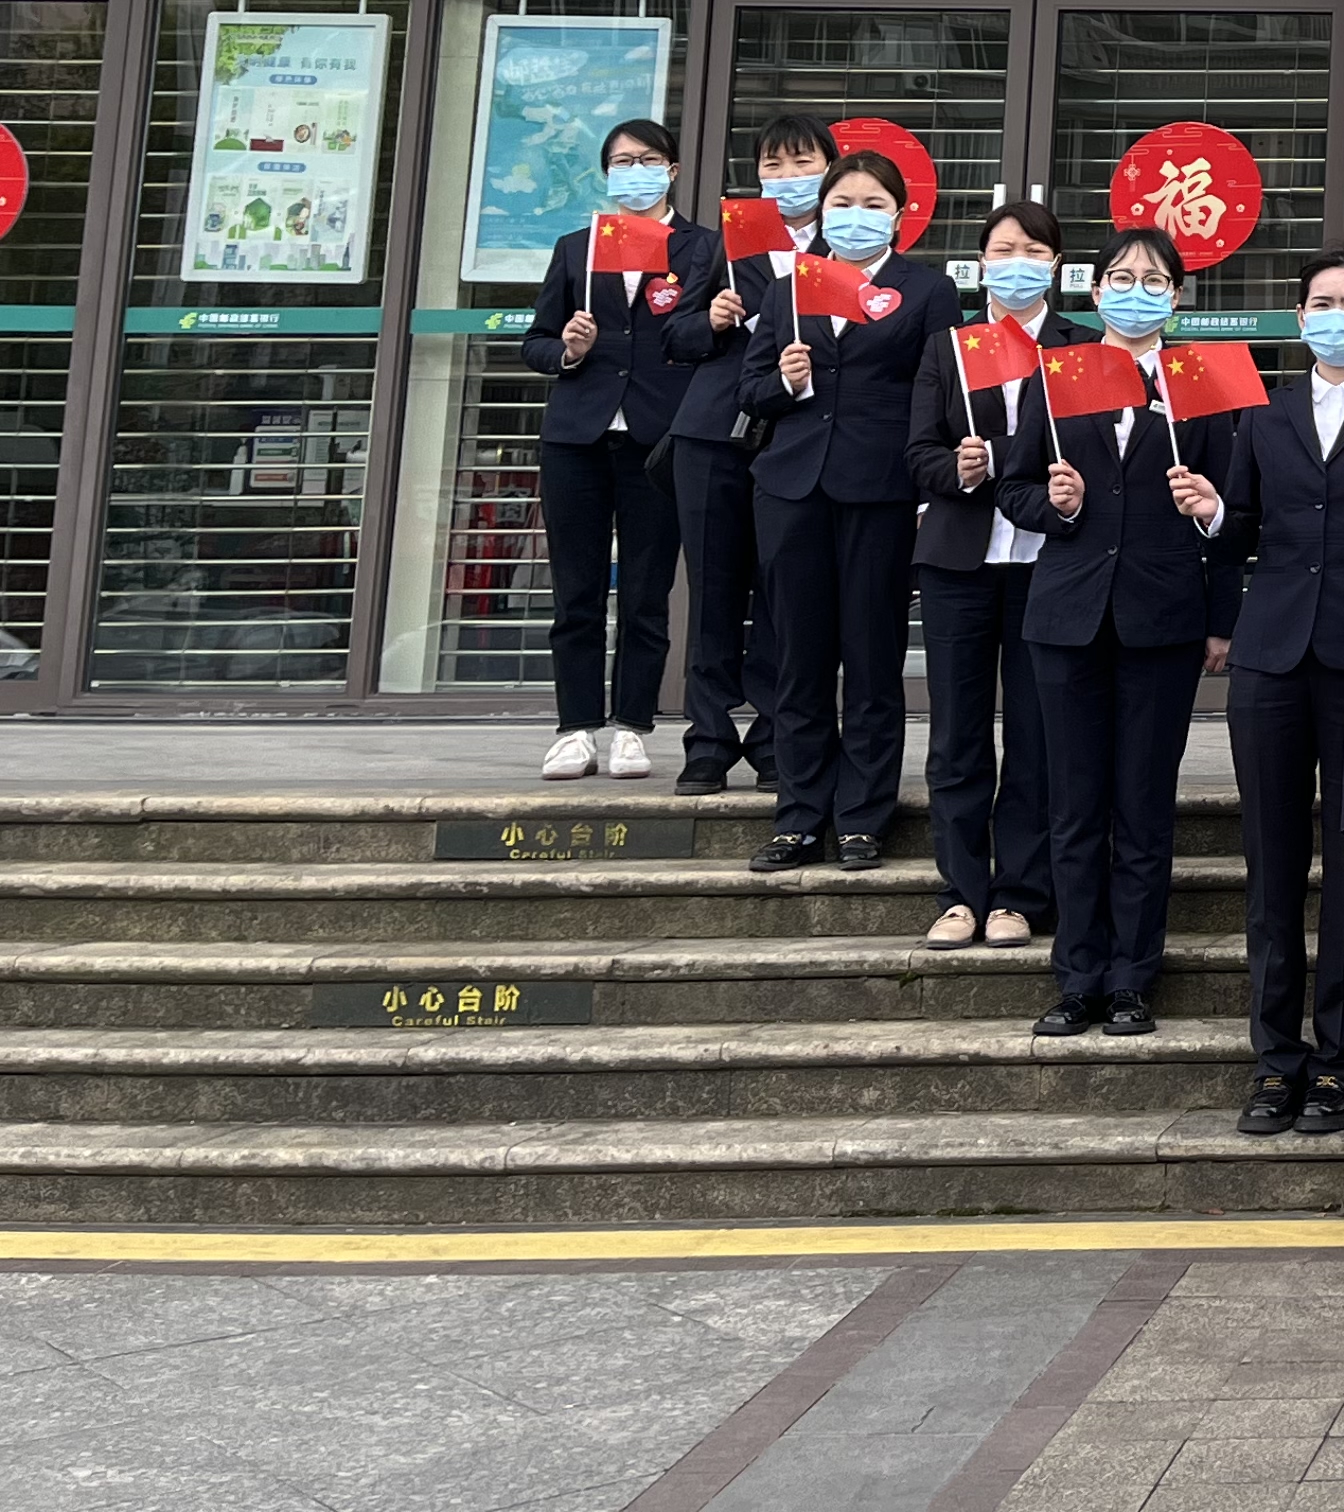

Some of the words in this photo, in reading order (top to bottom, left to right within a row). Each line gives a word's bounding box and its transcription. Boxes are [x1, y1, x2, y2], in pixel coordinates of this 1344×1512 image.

[1143, 156, 1227, 240] 福
[955, 264, 970, 279] 拉
[1070, 268, 1086, 283] 拉
[501, 822, 628, 847] 小心台阶
[382, 984, 521, 1013] 小心台阶
[391, 1015, 459, 1027] Careful
